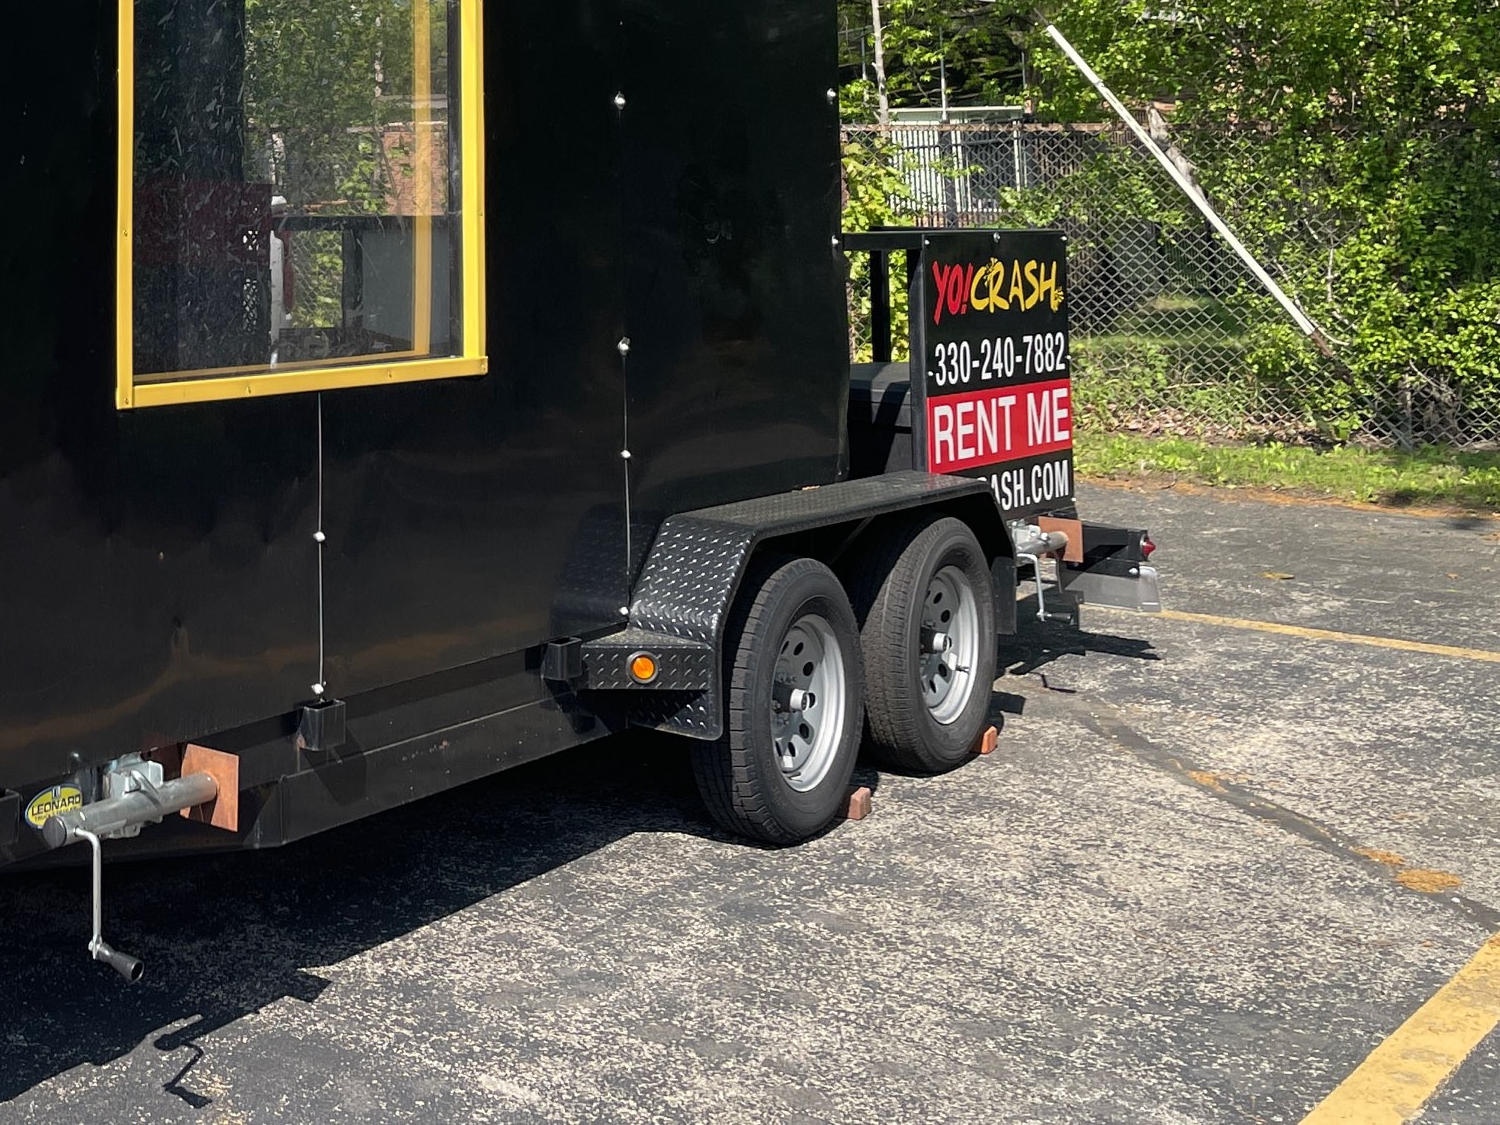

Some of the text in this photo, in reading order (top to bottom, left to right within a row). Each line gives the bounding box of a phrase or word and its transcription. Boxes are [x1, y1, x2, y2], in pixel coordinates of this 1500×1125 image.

[932, 258, 1064, 325] YO! CRASH
[935, 332, 1065, 385] 330-240-7882
[934, 389, 1069, 463] RENT ME
[978, 460, 1069, 510] ASH.COM
[31, 794, 81, 816] LEONARD
